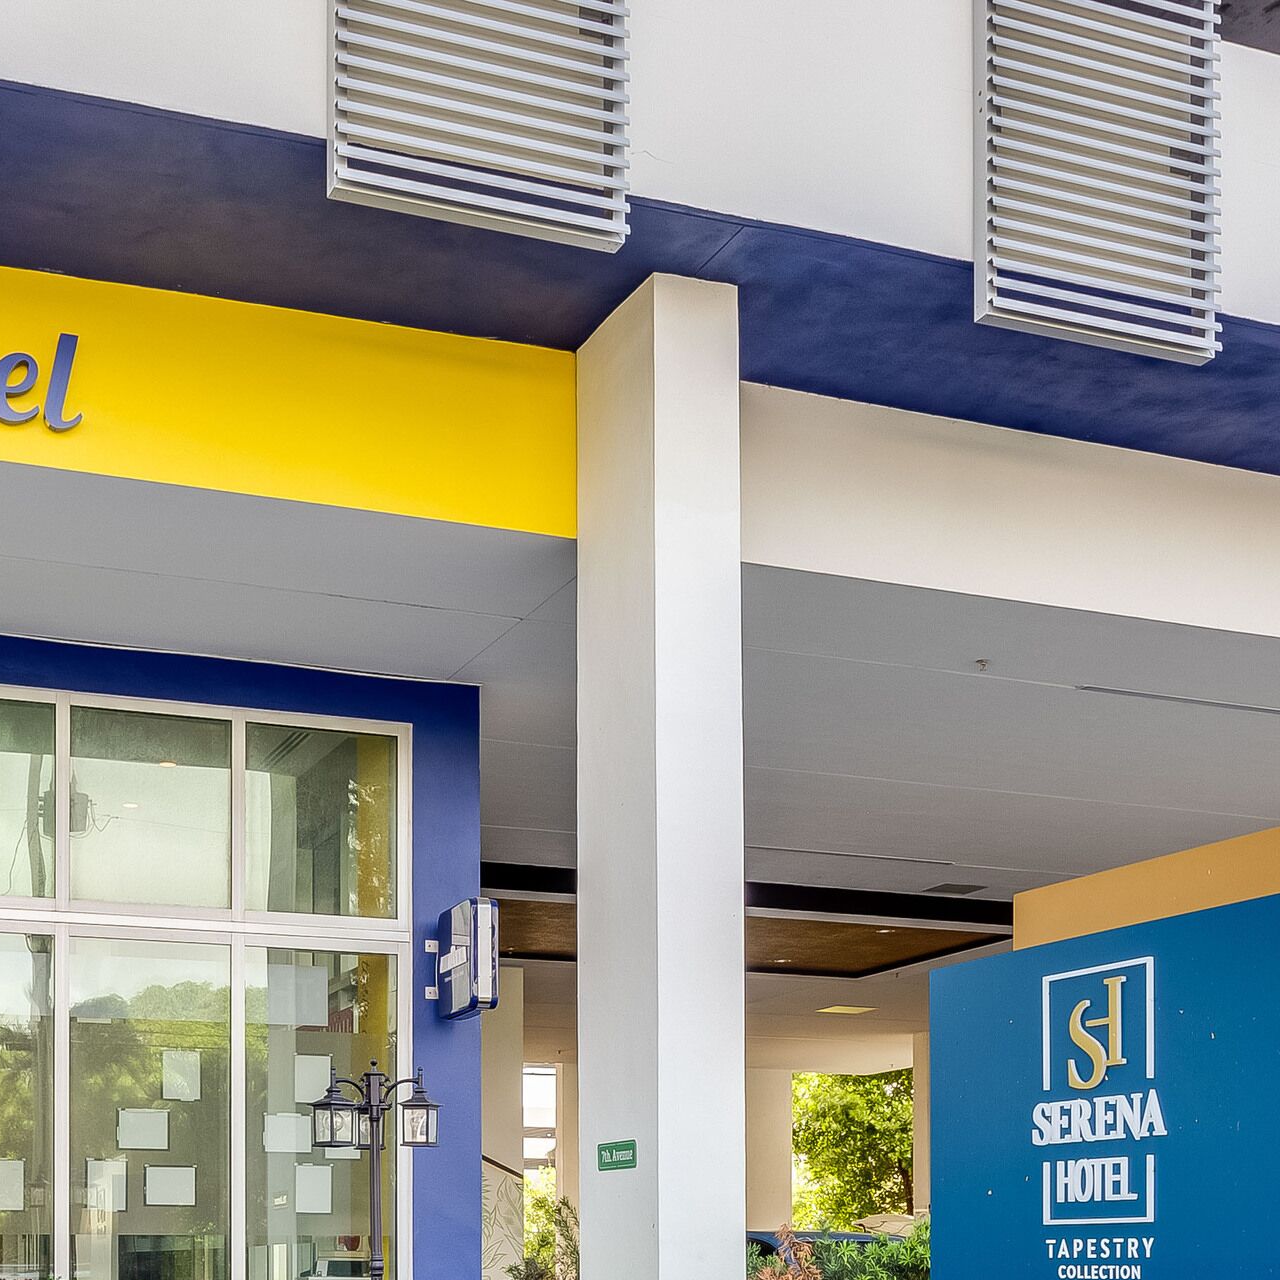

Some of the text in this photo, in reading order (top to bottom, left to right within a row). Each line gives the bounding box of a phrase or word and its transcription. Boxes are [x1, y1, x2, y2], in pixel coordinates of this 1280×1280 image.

[1031, 1088, 1168, 1146] SERENA
[1056, 1156, 1138, 1203] HOTEL
[1045, 1237, 1155, 1259] TAPESTRY
[1057, 1264, 1142, 1280] COLLECTION
